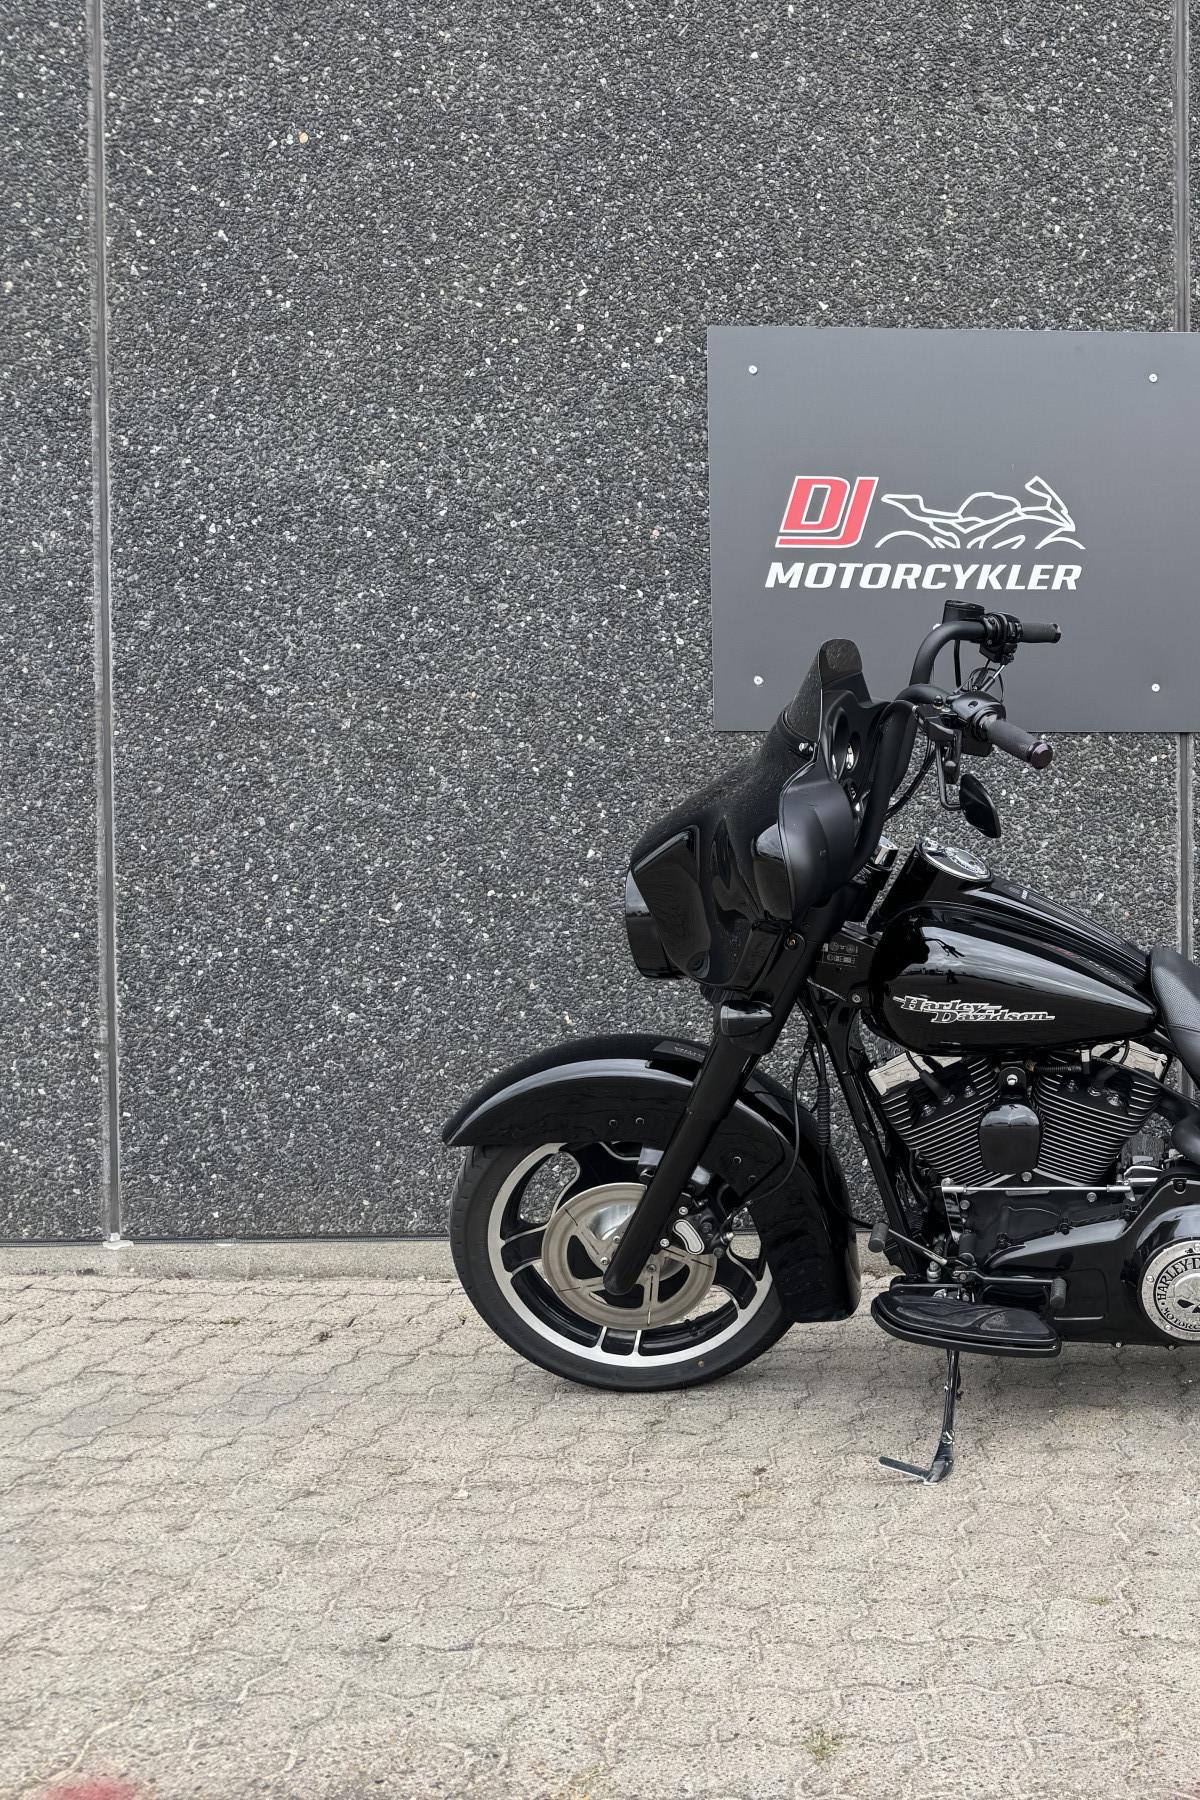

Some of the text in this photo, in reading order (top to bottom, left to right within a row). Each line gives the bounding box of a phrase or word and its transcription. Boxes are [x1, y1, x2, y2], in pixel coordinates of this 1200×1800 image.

[775, 476, 879, 548] DJ
[765, 562, 1082, 590] MOTORCYKLER
[931, 1009, 1056, 1024] Davidson
